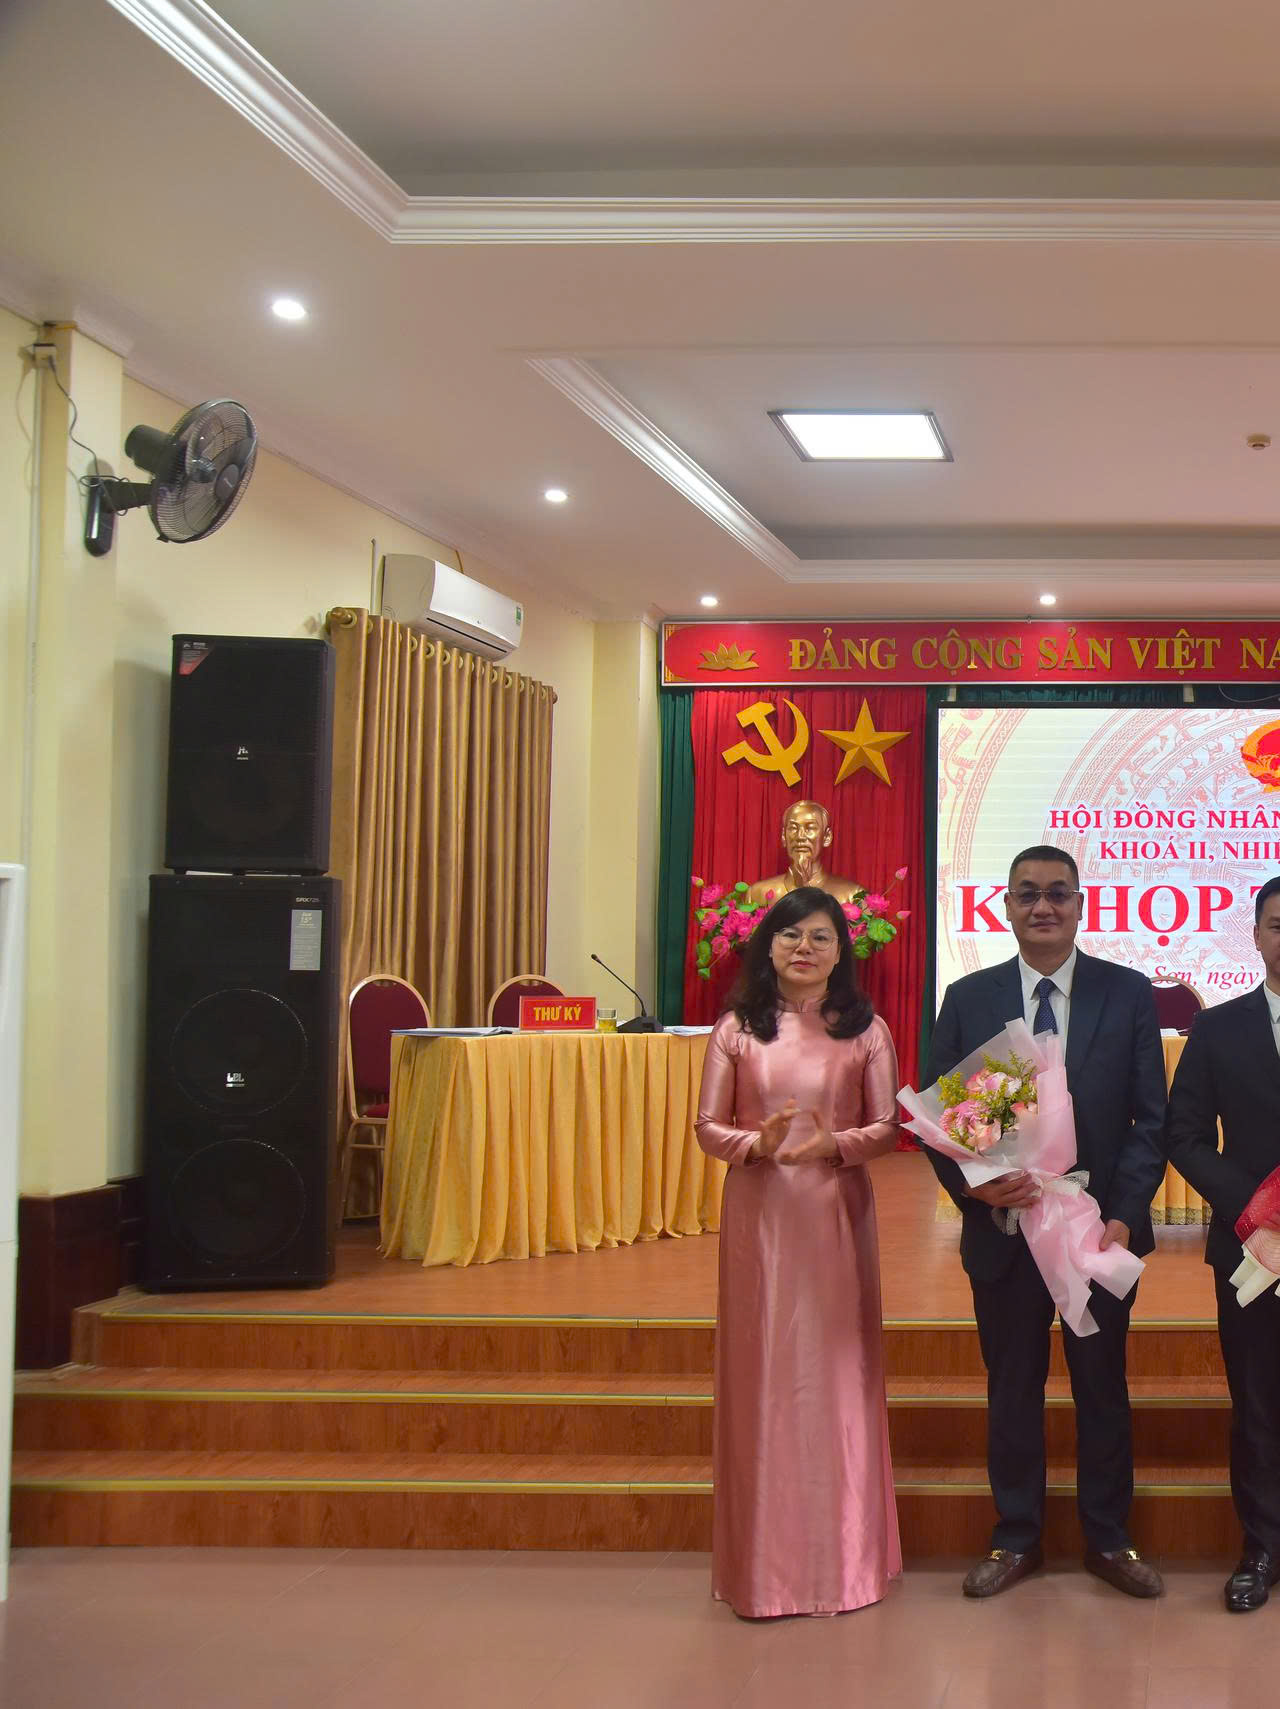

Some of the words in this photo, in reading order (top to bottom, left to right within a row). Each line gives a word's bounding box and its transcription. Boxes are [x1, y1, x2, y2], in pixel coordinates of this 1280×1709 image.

[789, 627, 898, 670] ĐẢNG
[912, 629, 1024, 676] CỘNG
[1038, 627, 1113, 670] SẢN
[1127, 628, 1221, 675] VIỆT
[1049, 804, 1103, 833] HỘI
[1113, 801, 1196, 829] ĐỒNG
[1099, 836, 1179, 860] KHOÁ
[1188, 841, 1215, 863] II,
[956, 885, 1010, 933] K
[1081, 884, 1234, 947] HỌP
[1206, 965, 1260, 990] ngày
[533, 1005, 562, 1021] THƯ
